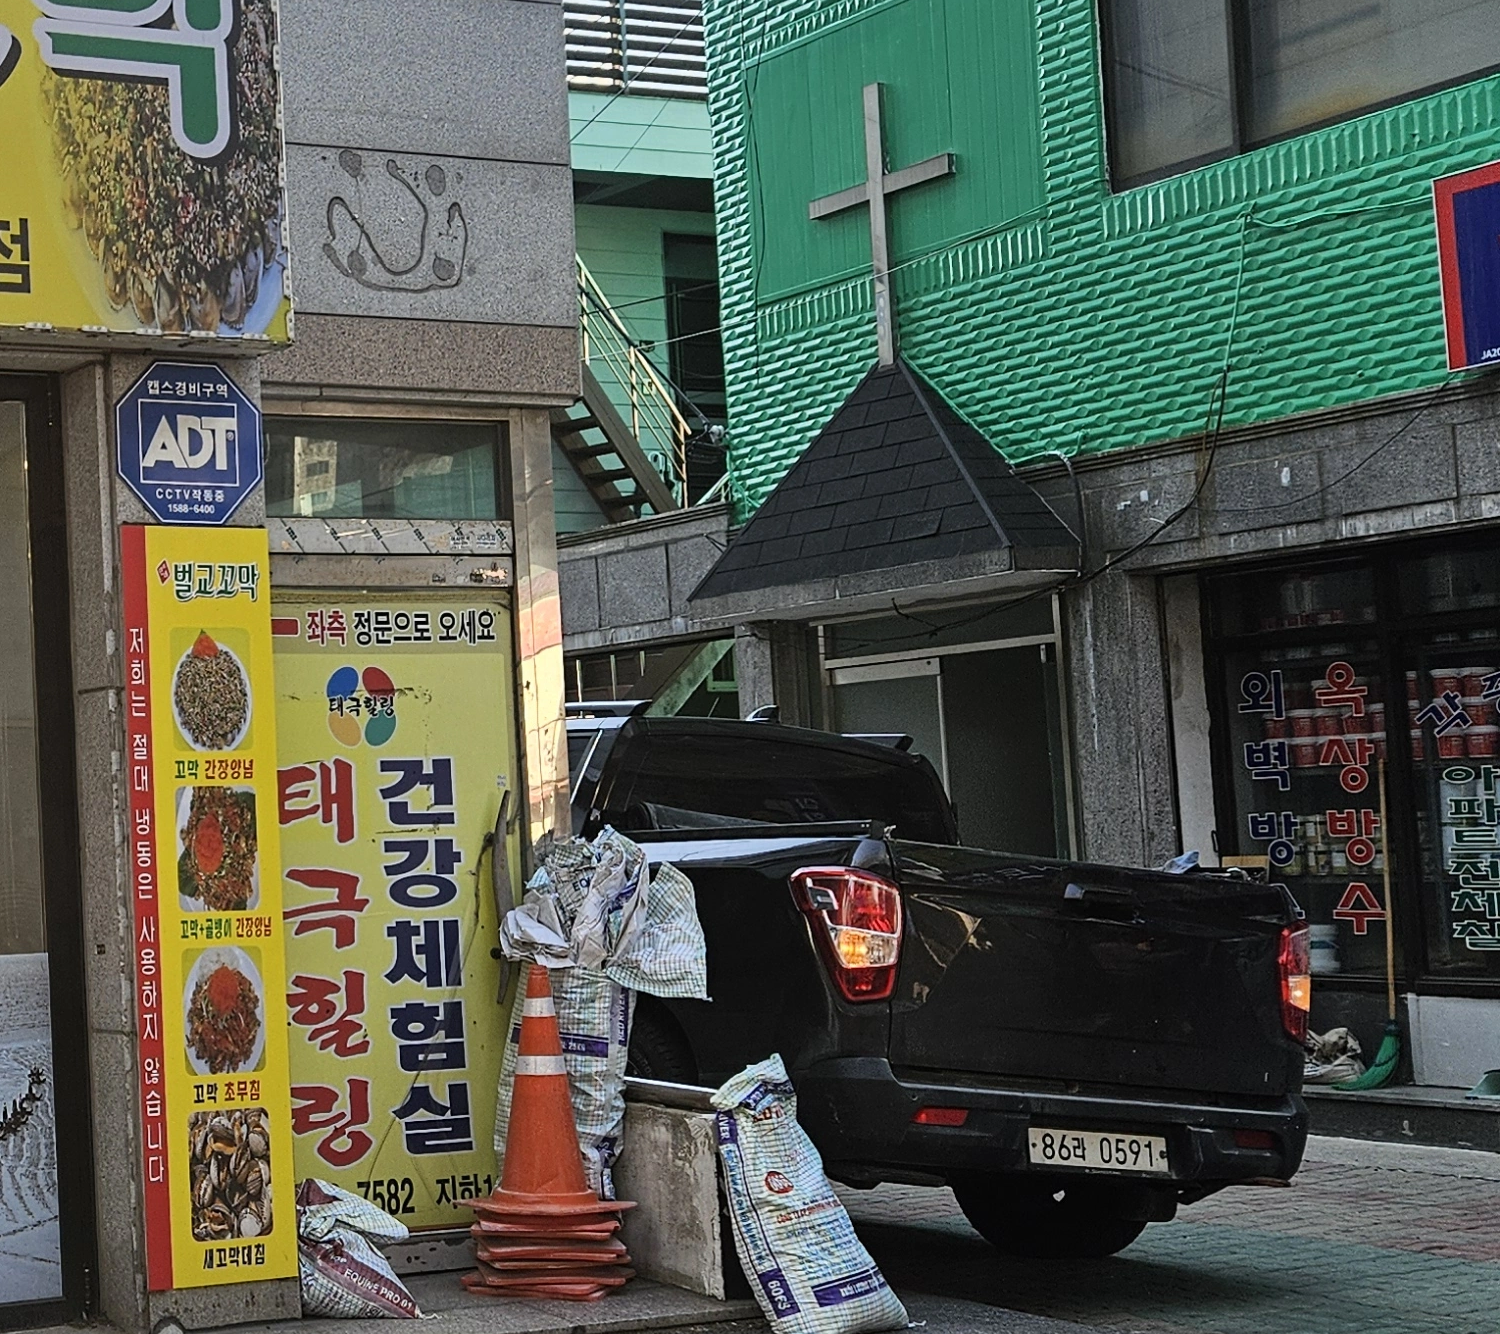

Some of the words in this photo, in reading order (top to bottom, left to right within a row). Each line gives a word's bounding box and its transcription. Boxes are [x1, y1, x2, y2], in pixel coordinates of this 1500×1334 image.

[147, 380, 228, 398] 캡스경비구역
[142, 414, 236, 471] ADT
[156, 487, 225, 503] CCTV작동중
[168, 504, 216, 515] 1588-6400
[173, 562, 260, 602] 벌교꼬막
[306, 609, 347, 646] 좌측
[353, 610, 432, 646] 정문으로
[438, 610, 496, 645] 오세요
[128, 627, 146, 717] 저희는
[328, 695, 395, 718] 태극힐링
[132, 733, 149, 792] 절대
[174, 759, 200, 780] 꼬막
[204, 758, 255, 780] 간장양념
[1238, 670, 1306, 919] 외벽방
[1315, 662, 1387, 935] 옥상방수
[134, 807, 153, 900] 냉동은
[235, 916, 272, 939] 간장양념
[379, 757, 474, 1156] 건강체험실
[139, 915, 159, 1041] 사용하지
[193, 1084, 219, 1104] 꼬막
[223, 1079, 261, 1102] 초무침
[144, 1057, 165, 1183] 않습니다
[1041, 1132, 1086, 1161] 86라
[1100, 1137, 1153, 1167] 0591
[202, 1242, 266, 1270] 새꼬막데침
